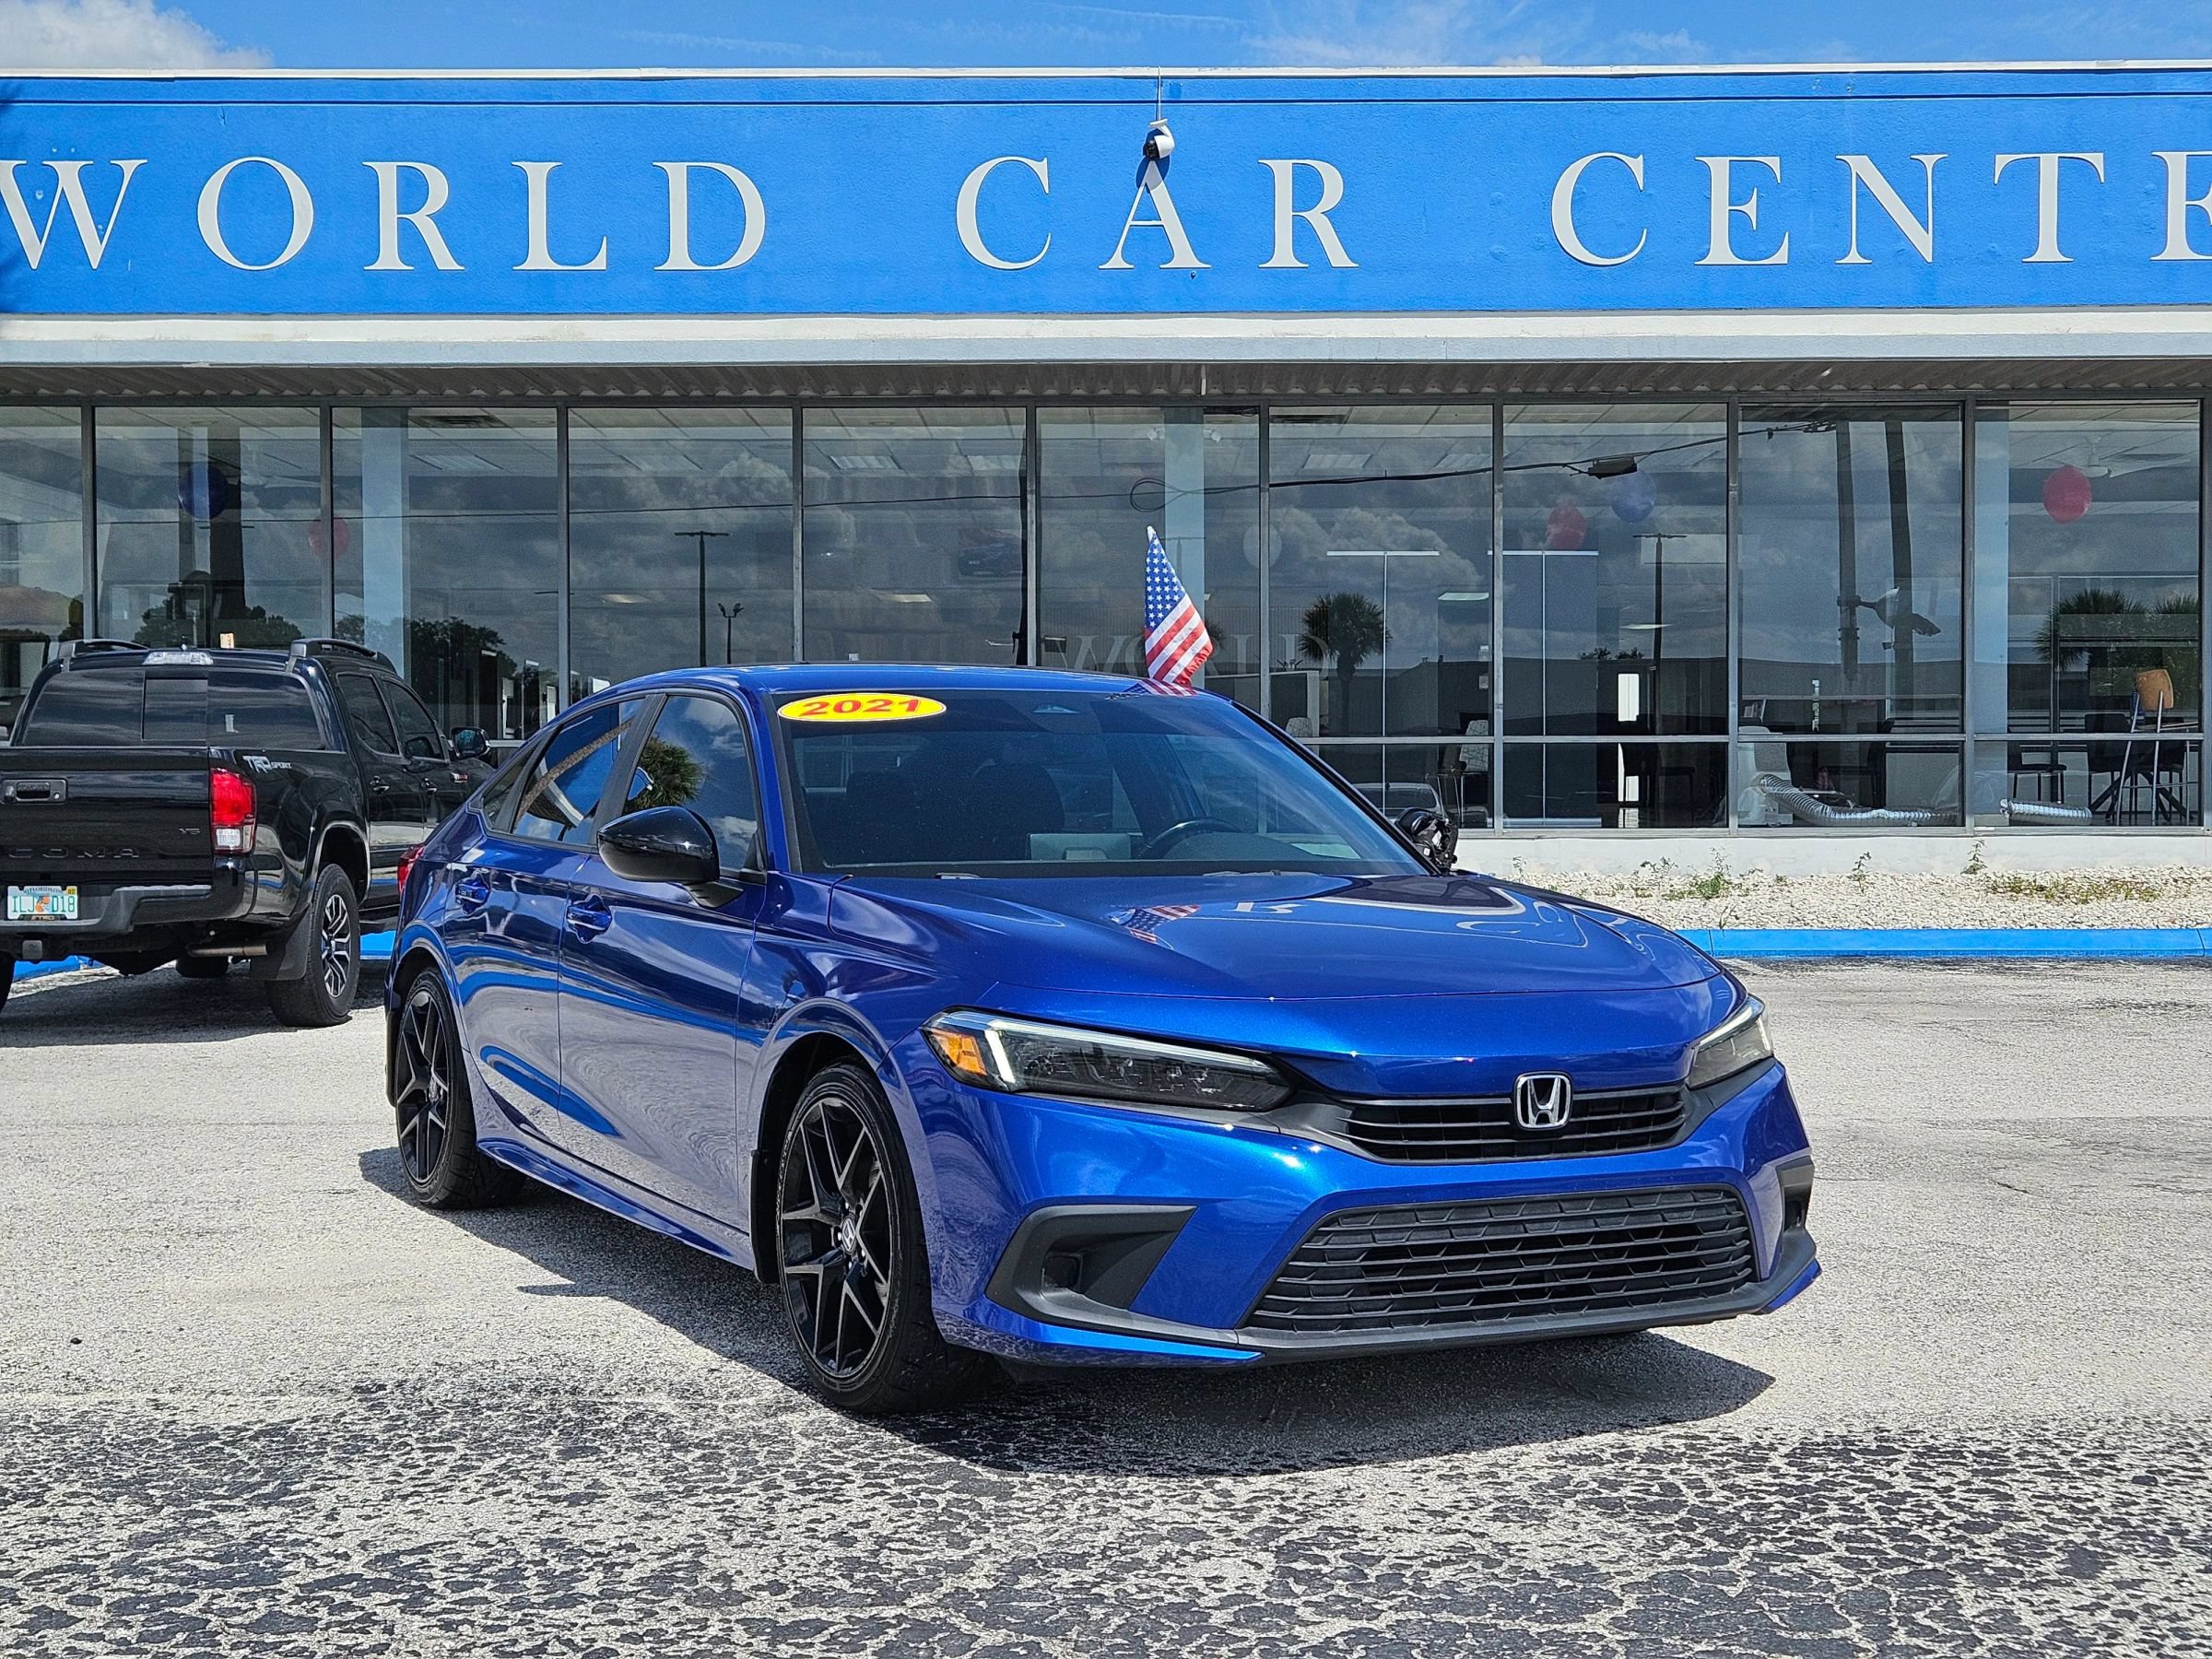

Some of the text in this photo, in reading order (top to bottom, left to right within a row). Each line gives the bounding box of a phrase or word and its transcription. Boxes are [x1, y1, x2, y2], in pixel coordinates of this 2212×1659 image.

[0, 156, 766, 271] WORLD
[955, 156, 1359, 270] CAR
[798, 699, 922, 717] 2021
[241, 755, 273, 774] TRD
